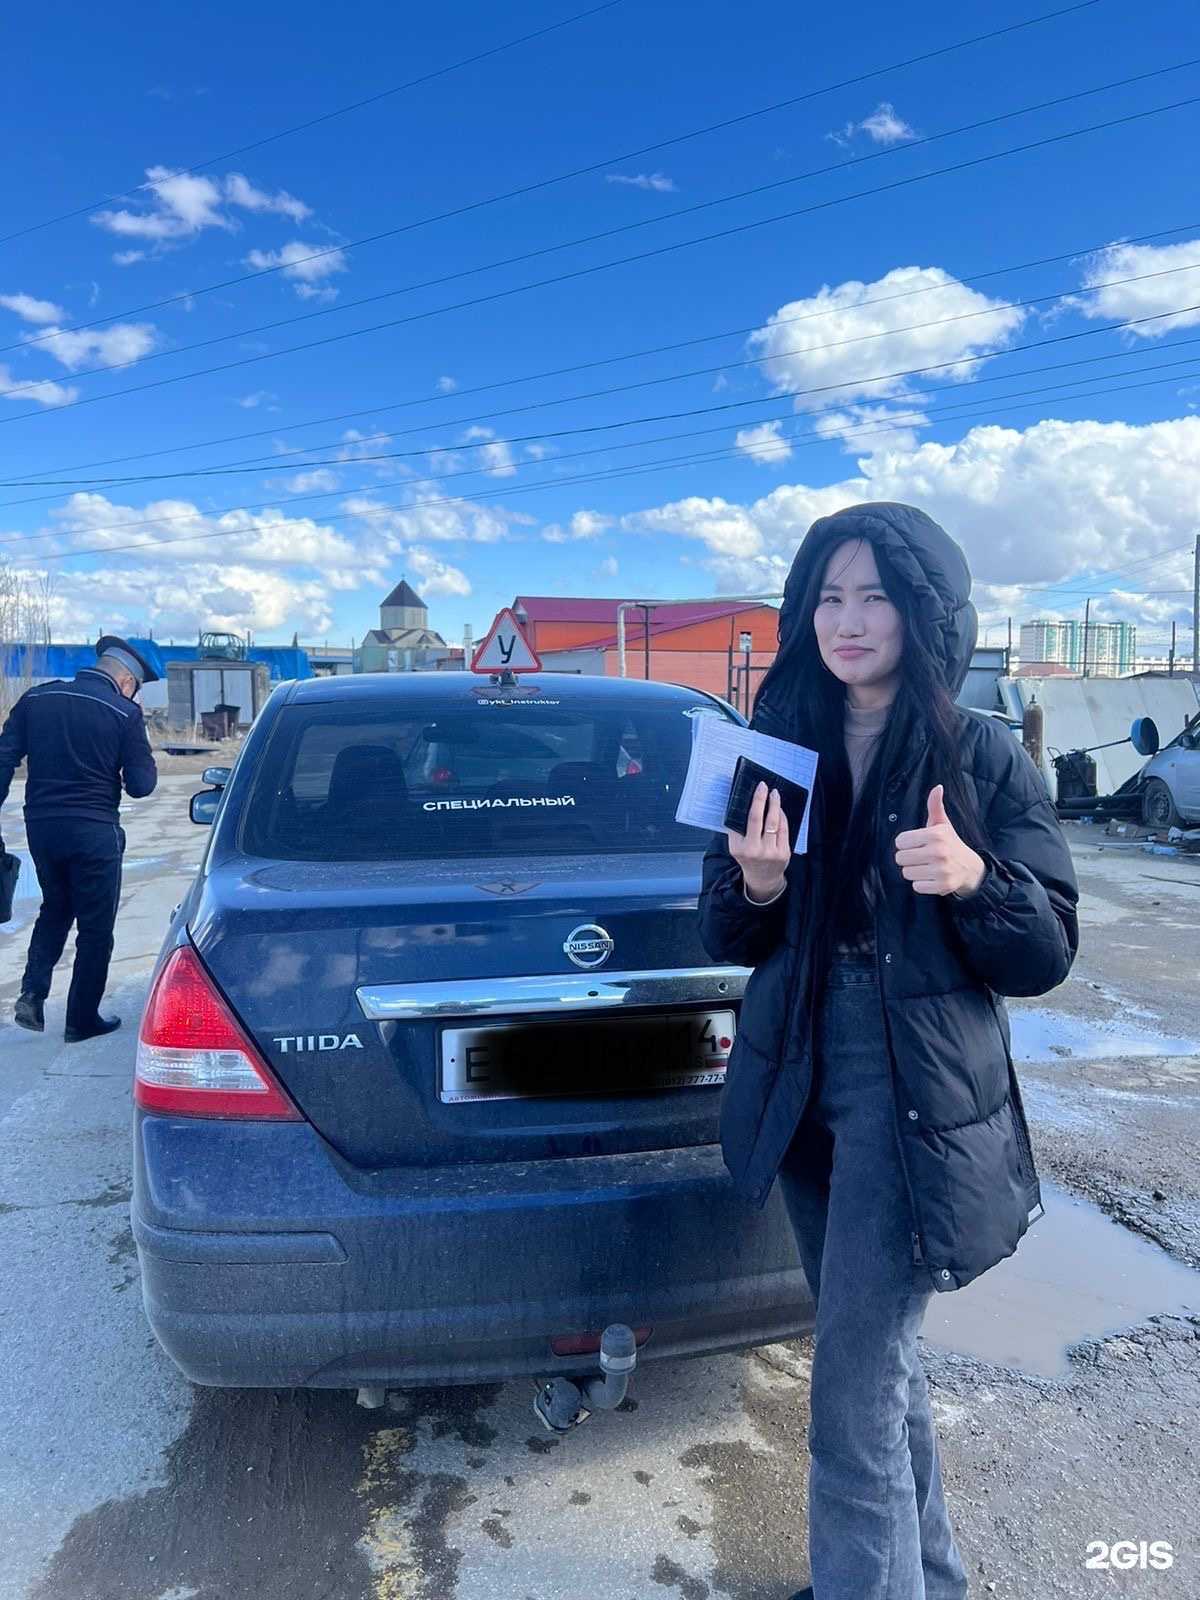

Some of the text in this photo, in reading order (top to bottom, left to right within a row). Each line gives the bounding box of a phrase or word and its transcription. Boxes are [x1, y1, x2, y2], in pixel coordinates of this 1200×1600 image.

[423, 795, 575, 811] СПЕЦИАЛЬНЫЙ
[569, 942, 609, 951] NISSAN
[273, 1034, 364, 1053] TIIDA
